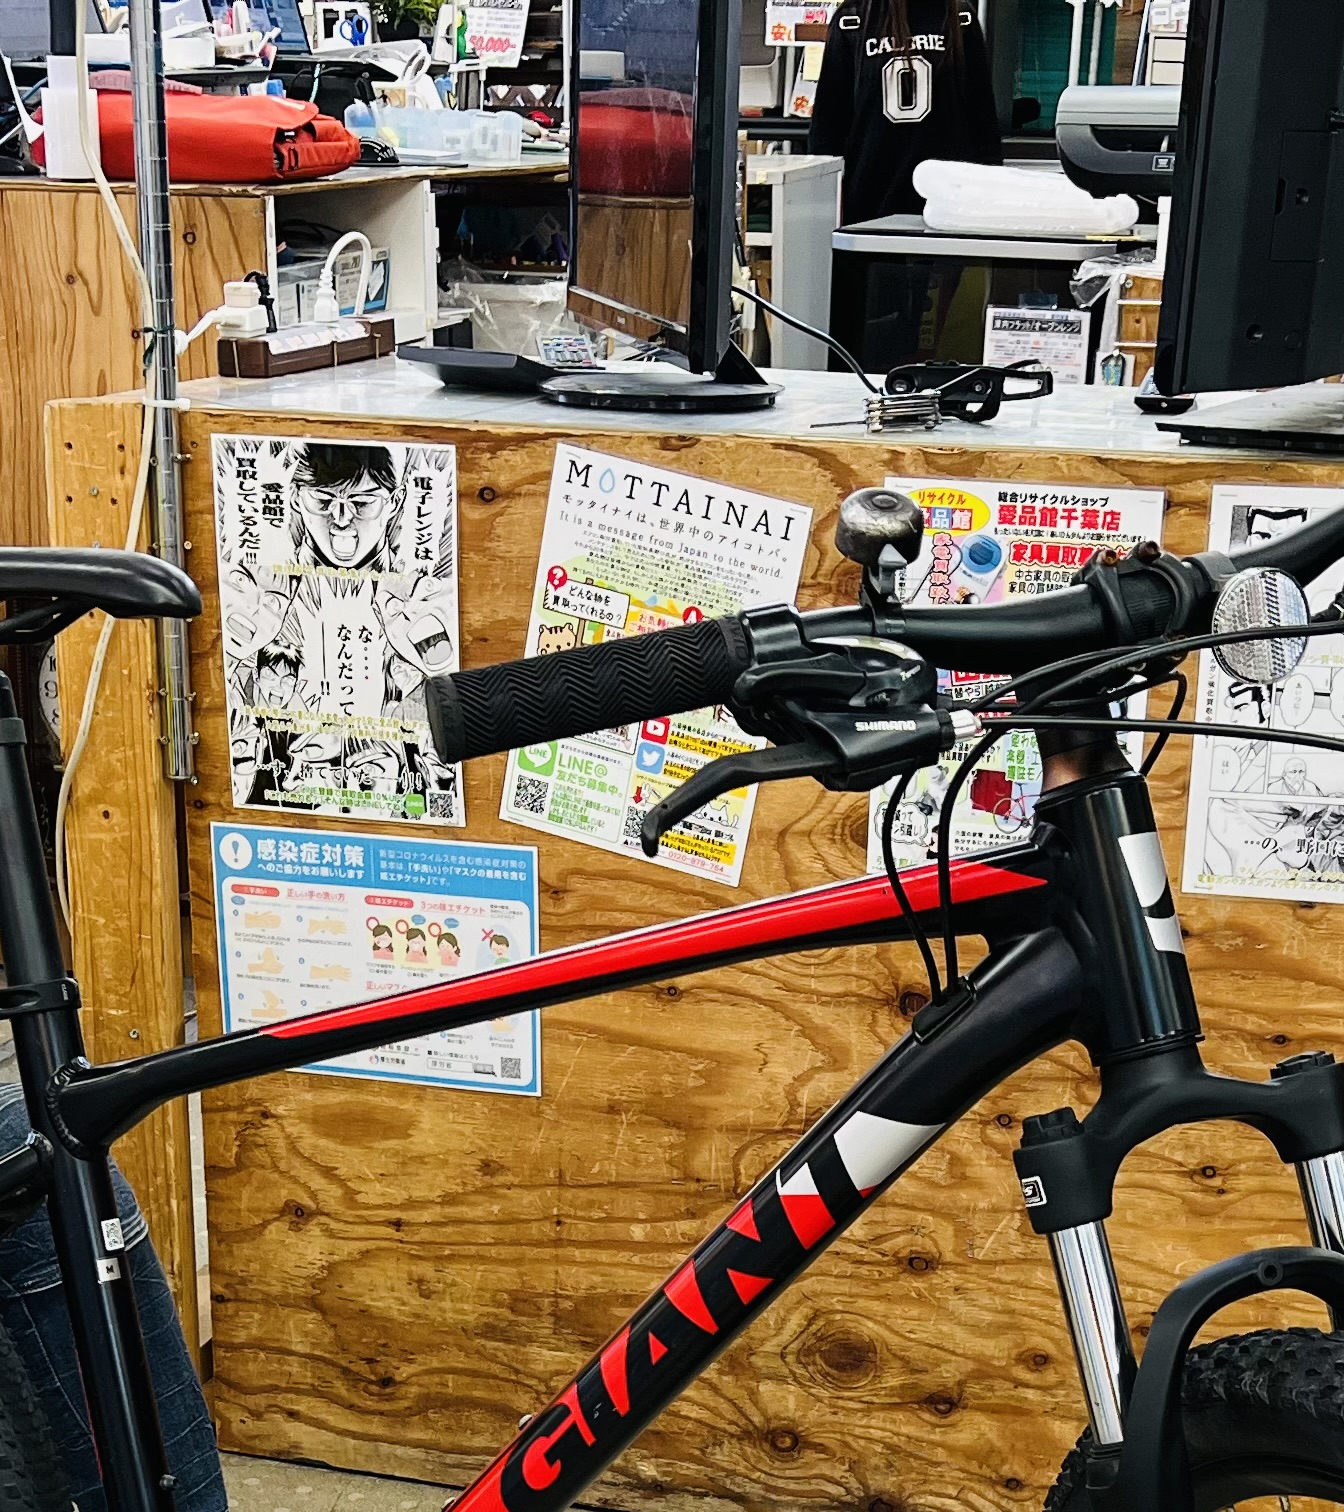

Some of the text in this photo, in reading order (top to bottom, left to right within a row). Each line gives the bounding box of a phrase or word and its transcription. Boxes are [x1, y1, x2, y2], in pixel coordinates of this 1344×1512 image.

[918, 490, 966, 506] リサイクル
[997, 491, 1110, 508] 総合リサイクルショップ
[412, 475, 435, 561] 電子レンジは
[997, 504, 1122, 532] 愛品館千葉店
[597, 522, 644, 542] message
[648, 534, 675, 550] from
[855, 720, 917, 732] SHIMANO
[558, 752, 608, 778] LINE@
[256, 838, 365, 868] 感染症対策
[257, 862, 365, 880] へのご協力をお願いします
